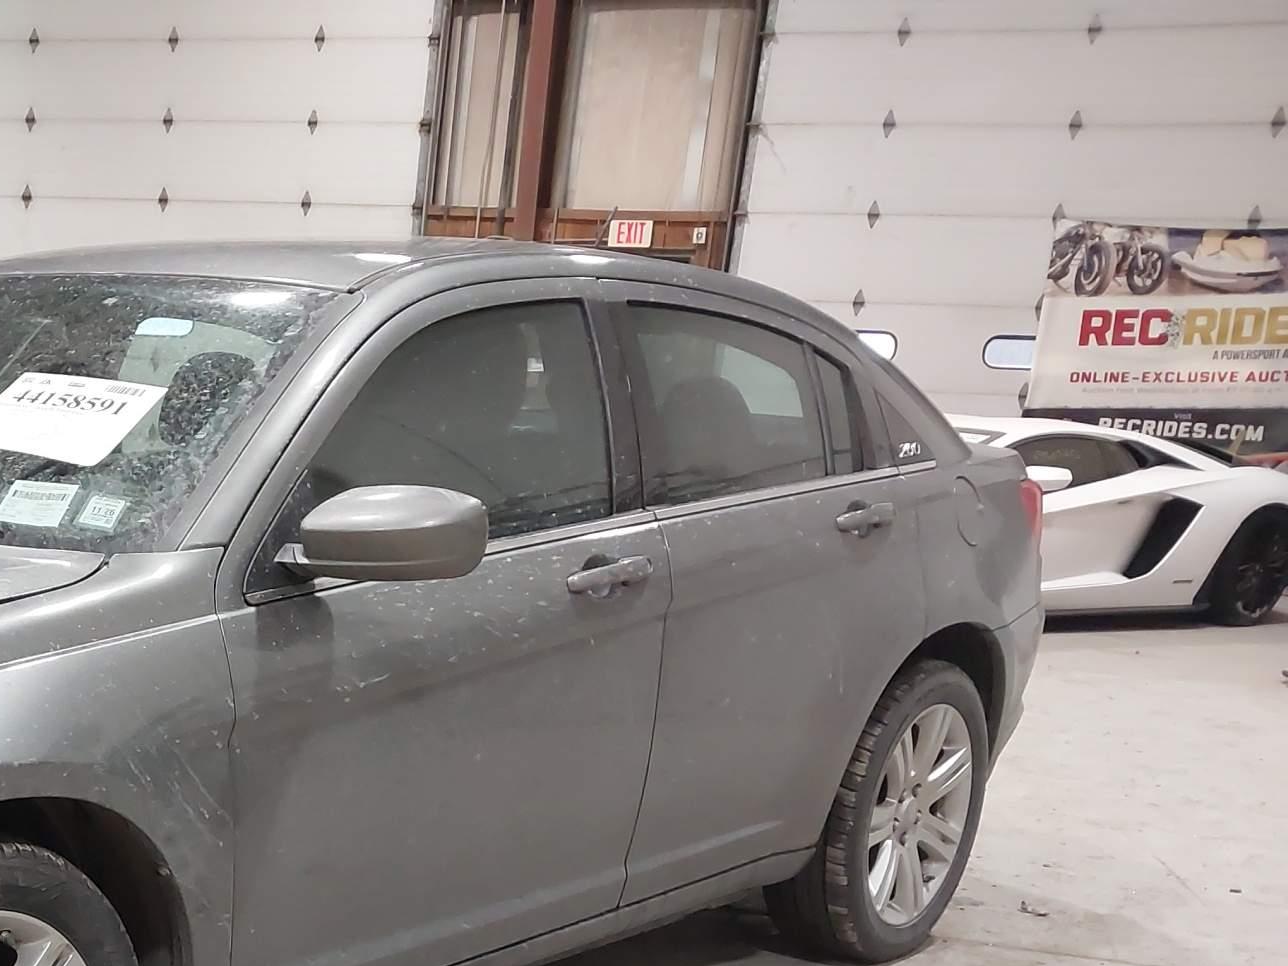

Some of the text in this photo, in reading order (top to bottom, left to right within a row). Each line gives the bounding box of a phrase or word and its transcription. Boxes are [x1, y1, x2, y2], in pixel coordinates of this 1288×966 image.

[616, 222, 647, 244] EXIT
[1078, 308, 1174, 346] REC
[1221, 349, 1280, 361] POWERSPORT
[1069, 371, 1239, 383] ONLINE-EXCLUSIVE
[13, 389, 128, 415] 44158591
